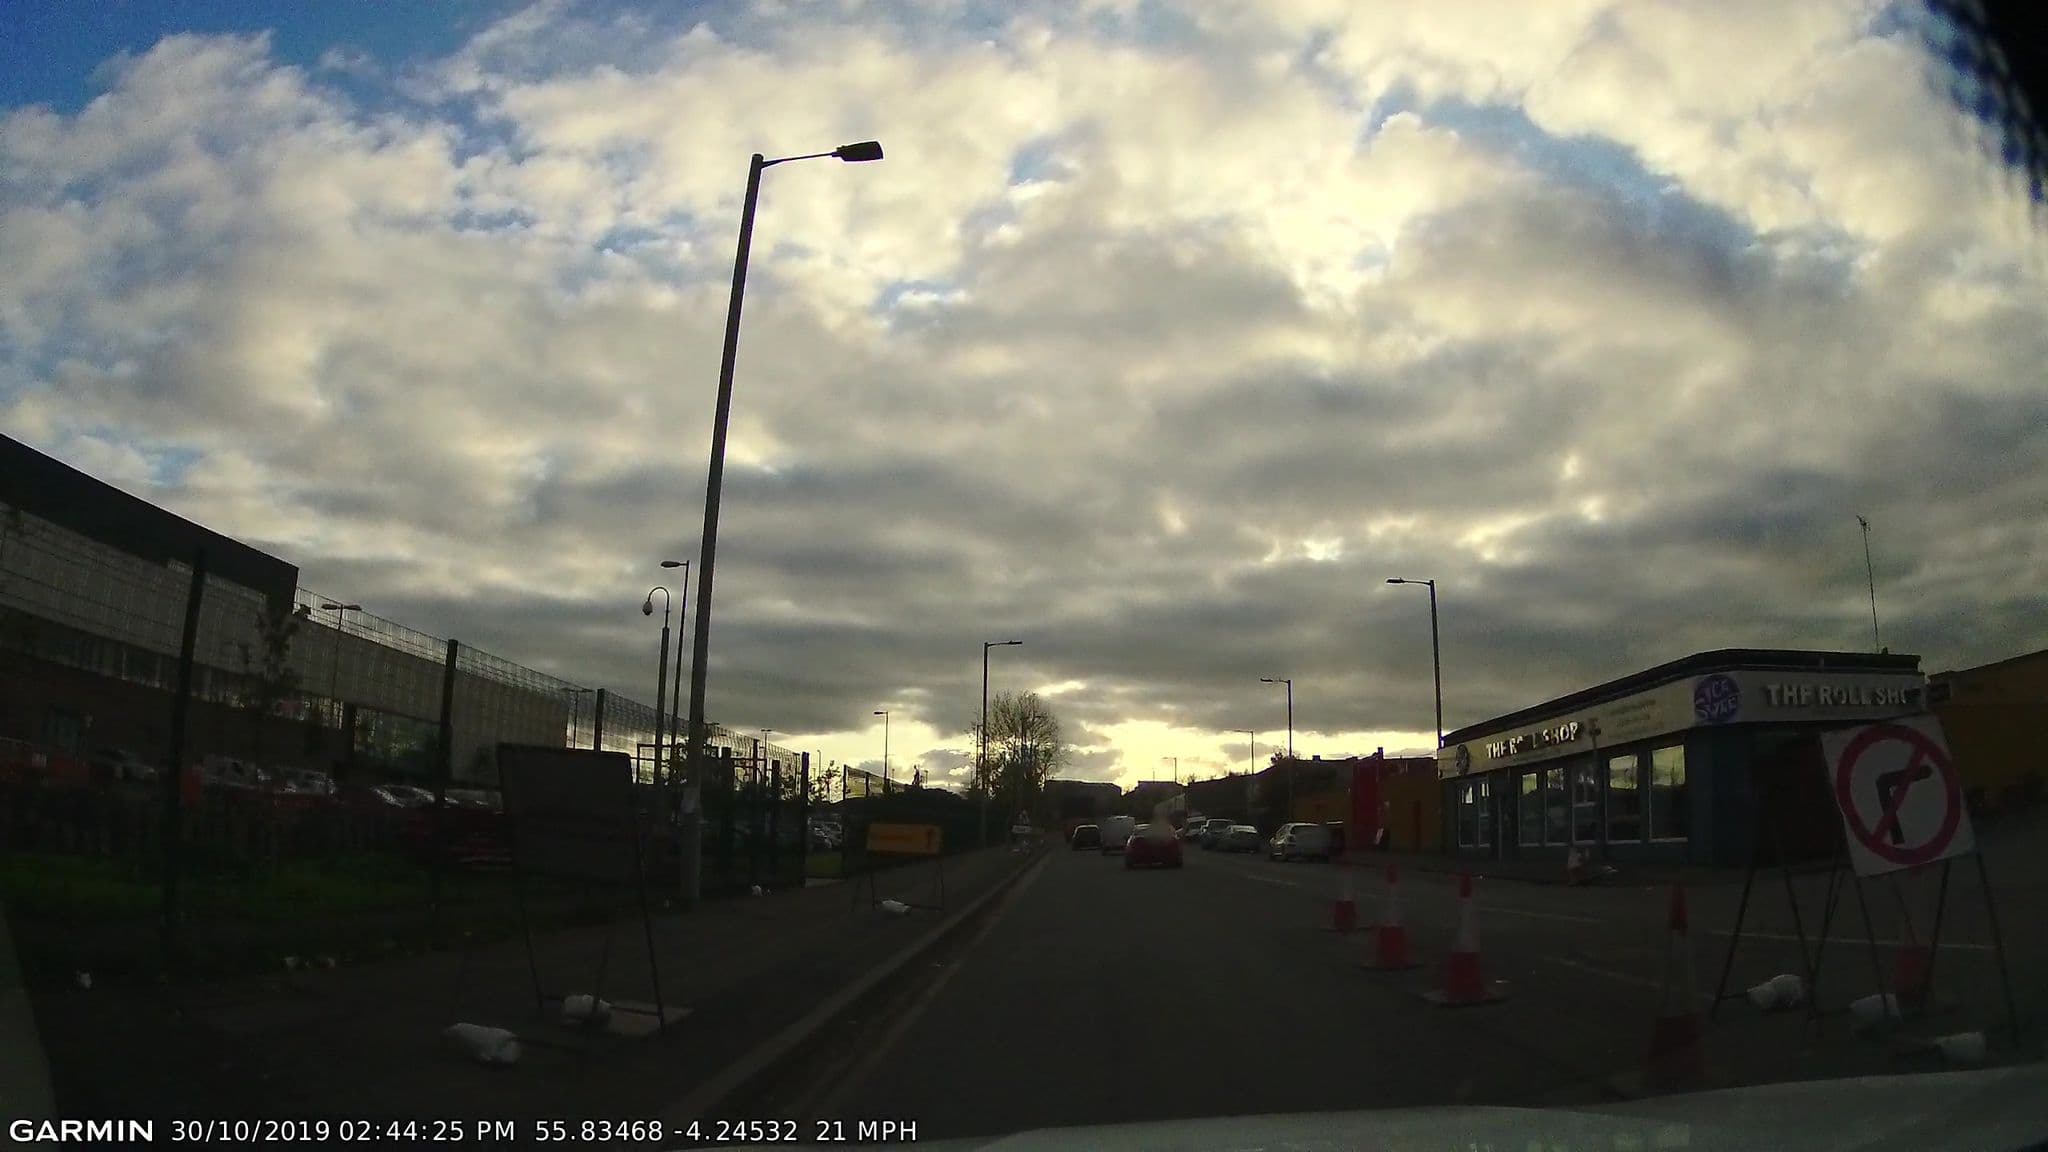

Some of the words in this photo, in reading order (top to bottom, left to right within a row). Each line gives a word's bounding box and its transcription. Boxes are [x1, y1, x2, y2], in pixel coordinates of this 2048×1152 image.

[1767, 683, 1812, 705] THE
[1819, 685, 1872, 705] ROLL
[1485, 742, 1506, 759] THE
[1542, 721, 1579, 745] SHOP
